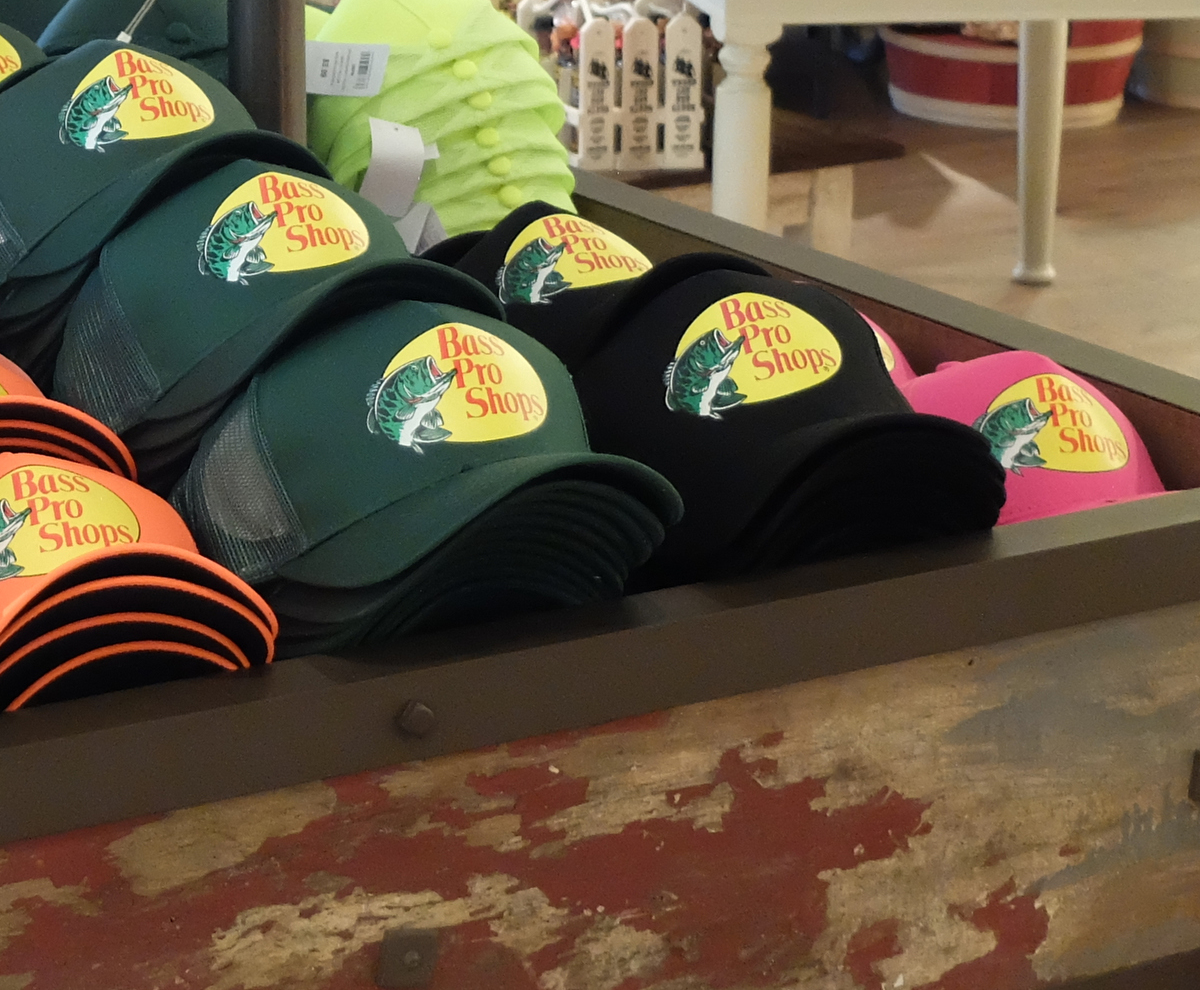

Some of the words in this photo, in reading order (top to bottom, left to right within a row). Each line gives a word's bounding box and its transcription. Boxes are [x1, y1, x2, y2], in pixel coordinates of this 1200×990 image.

[114, 50, 174, 78] Bass
[128, 74, 174, 99] Pro
[139, 96, 211, 122] Shops
[258, 175, 325, 204] Bass
[273, 201, 323, 228] Pro
[542, 216, 606, 239] Bass
[285, 224, 365, 253] Shops
[560, 234, 607, 255] Pro
[574, 251, 647, 274] Shops
[719, 297, 791, 331] Bass
[436, 326, 505, 360] Bass
[738, 324, 792, 355] Pro
[452, 358, 503, 389] Pro
[752, 348, 837, 381] Shops
[465, 387, 544, 421] Shops
[1035, 376, 1094, 406] Bass
[1051, 402, 1093, 427] Pro
[1059, 427, 1127, 461] Shops
[11, 469, 90, 501] Bass
[26, 496, 83, 526] Pro
[38, 521, 134, 553] Shops
